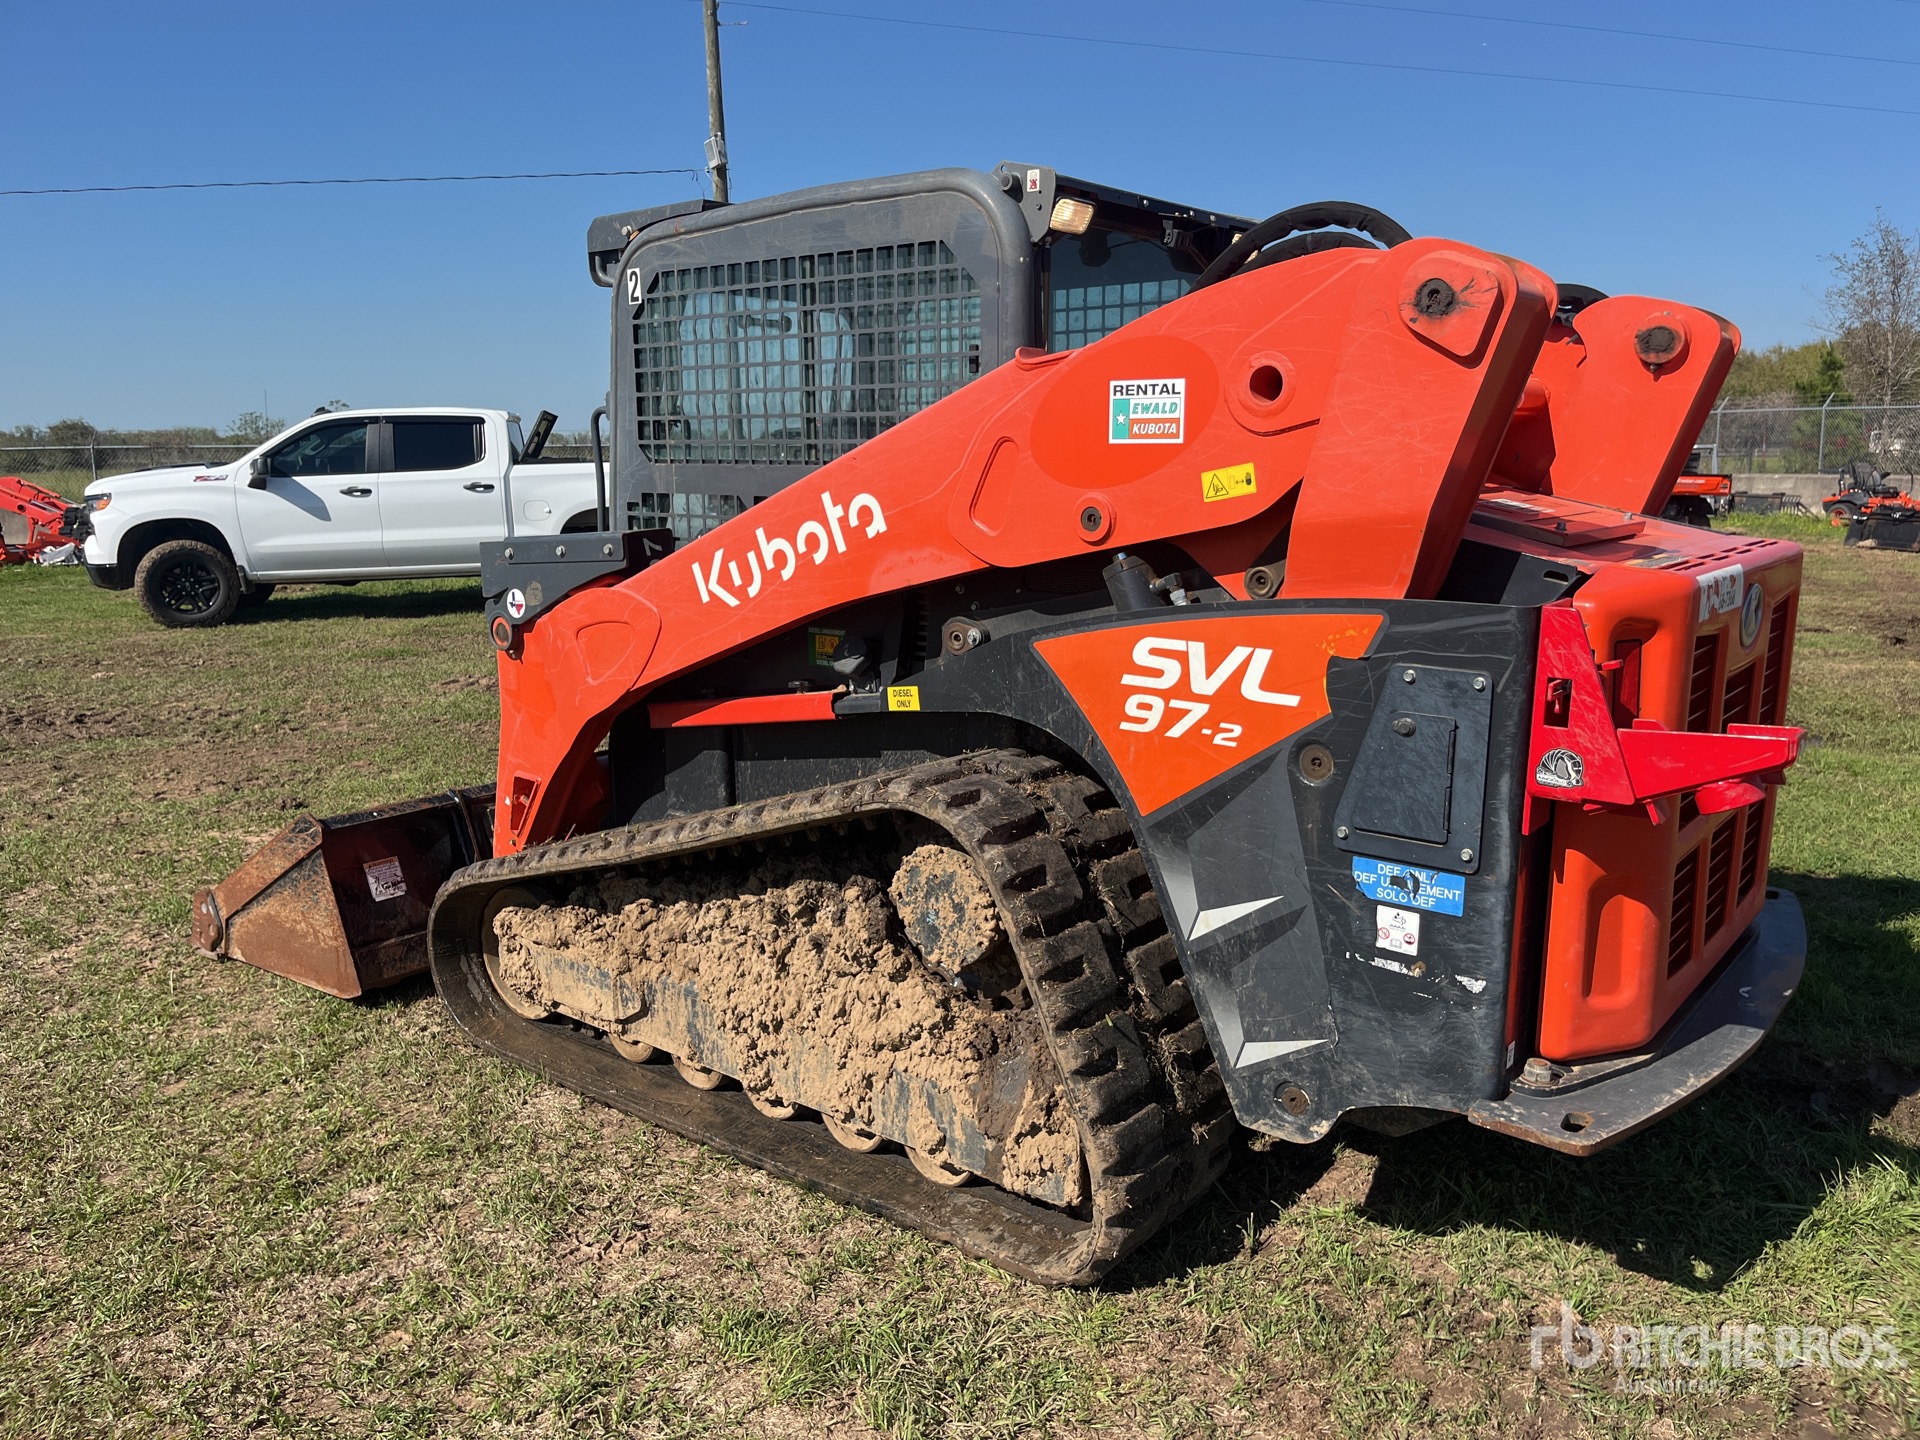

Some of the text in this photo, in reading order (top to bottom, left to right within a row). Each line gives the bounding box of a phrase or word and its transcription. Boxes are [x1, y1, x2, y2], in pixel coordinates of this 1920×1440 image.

[629, 270, 640, 303] 2
[1112, 382, 1181, 397] RENTAL
[1131, 401, 1179, 415] EWALD
[1131, 422, 1177, 435] KUBOTA
[691, 491, 887, 608] Kubota
[1120, 636, 1301, 708] SVL
[892, 688, 914, 698] DIESEL
[896, 699, 912, 709] ONLY
[1119, 693, 1243, 748] 97-2
[1353, 870, 1378, 885] DEF
[1377, 863, 1402, 877] DEF
[1376, 887, 1437, 908] SOLO DEF
